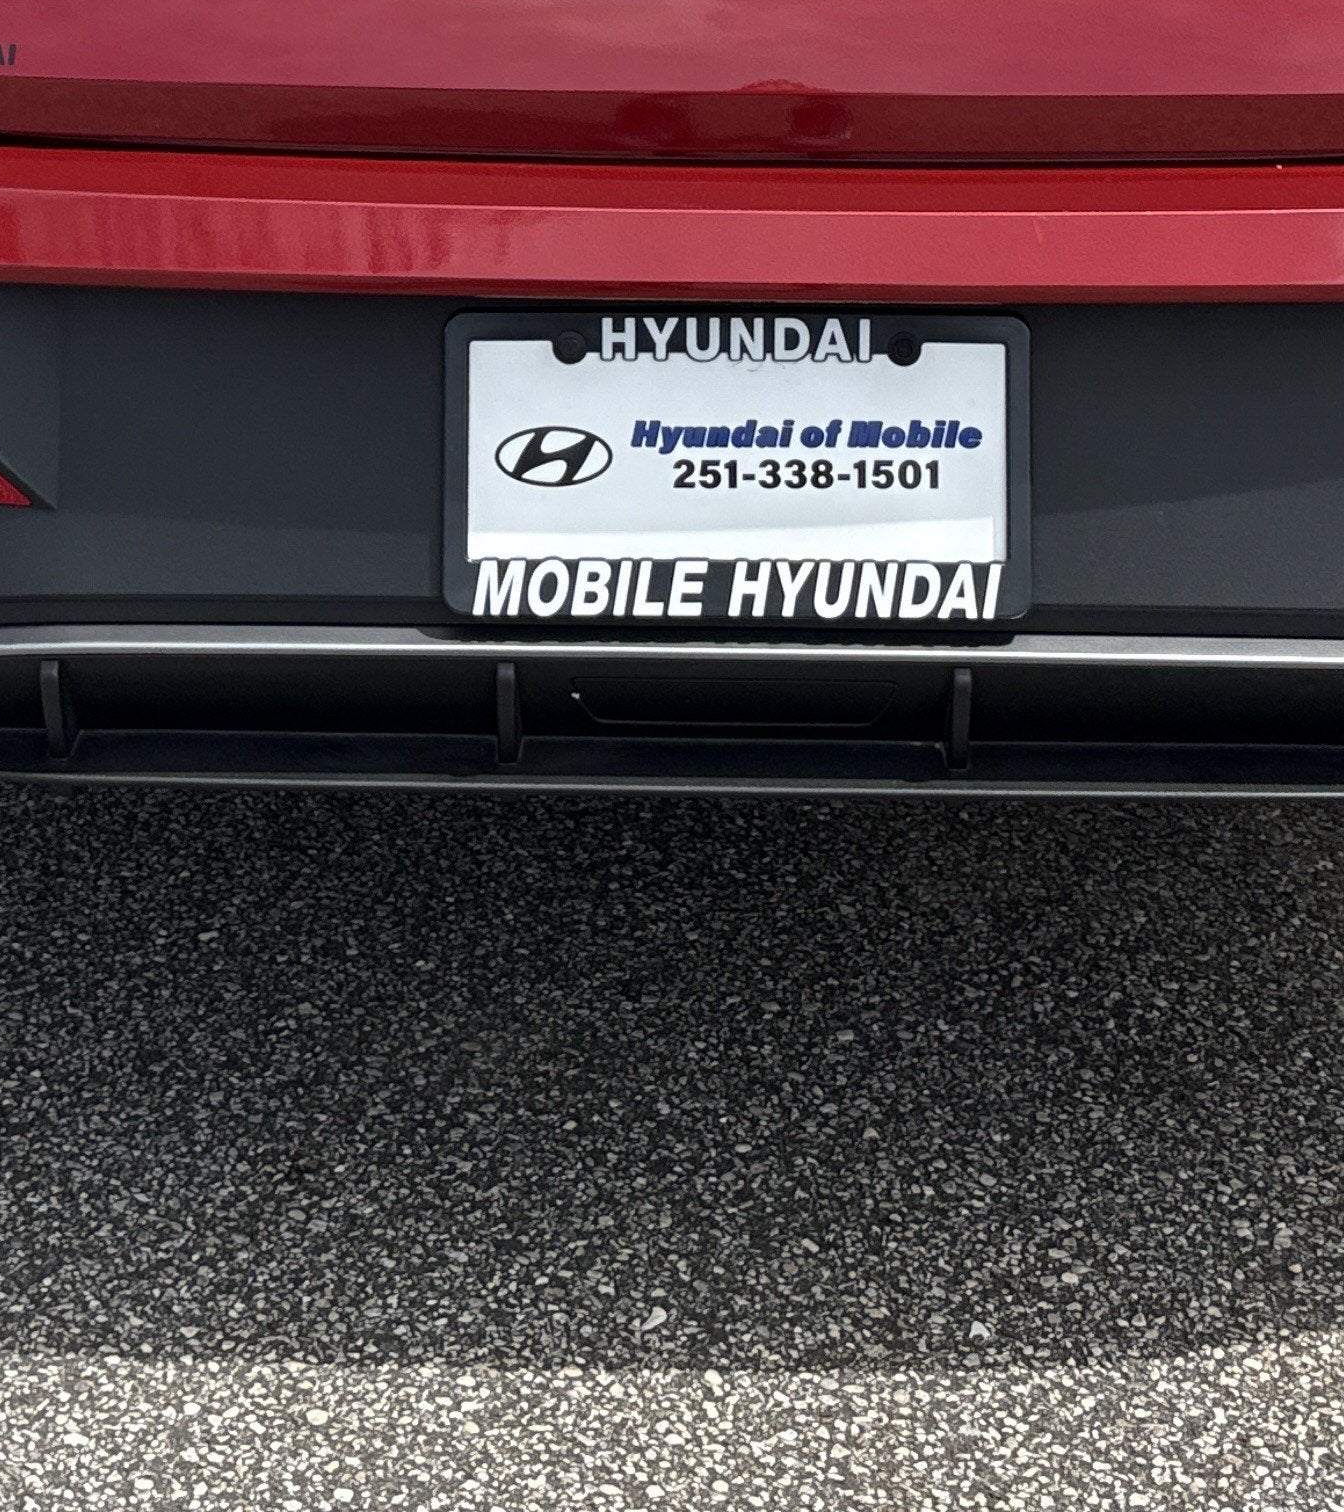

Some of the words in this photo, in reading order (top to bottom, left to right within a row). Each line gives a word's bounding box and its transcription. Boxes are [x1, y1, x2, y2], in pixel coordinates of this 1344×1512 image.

[601, 317, 871, 362] HYUNDAI
[630, 419, 795, 454] Hyundai
[800, 419, 844, 449] of
[846, 419, 984, 450] Mobile
[672, 458, 940, 490] 251-338-1501
[471, 559, 709, 618] MOBILE
[727, 560, 1004, 620] HYUNDAI
